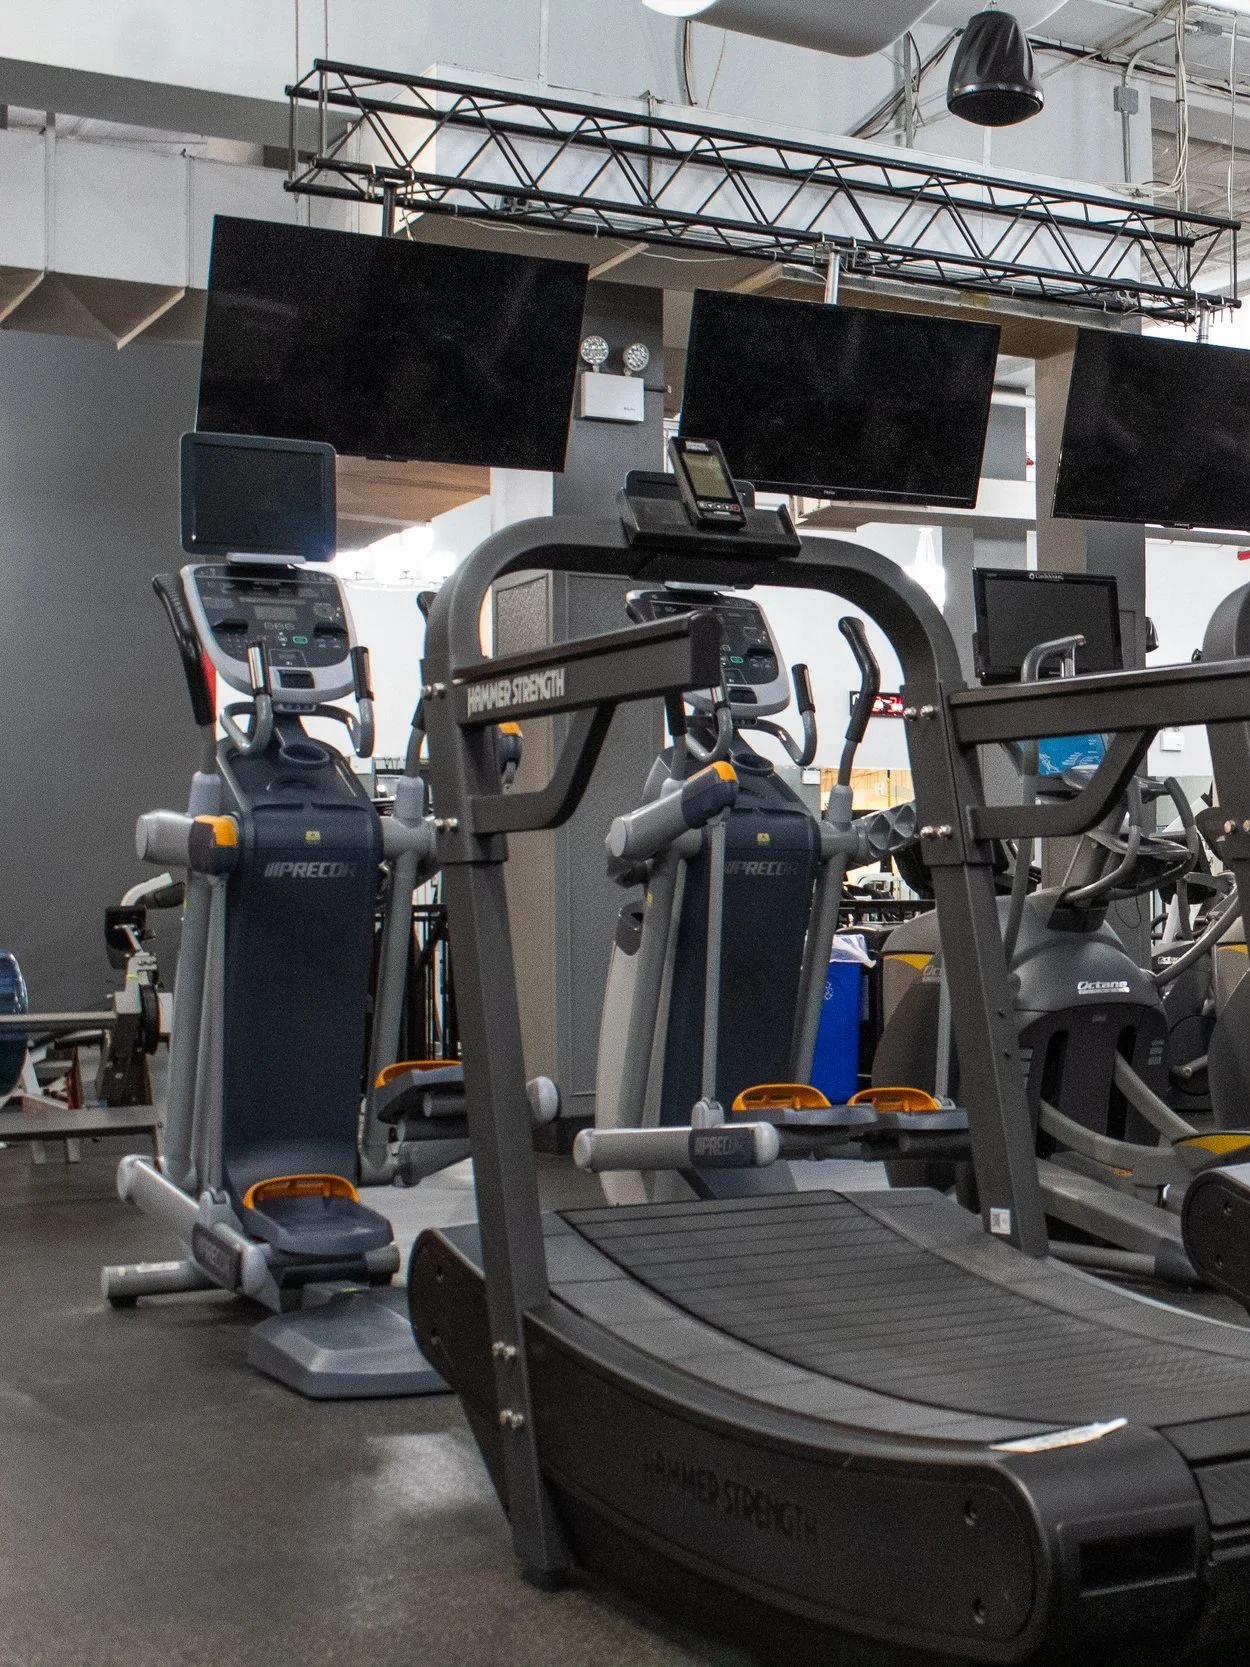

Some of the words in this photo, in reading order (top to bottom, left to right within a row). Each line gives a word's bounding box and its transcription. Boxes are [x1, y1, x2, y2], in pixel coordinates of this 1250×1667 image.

[467, 679, 511, 718] HAMMER
[512, 667, 566, 705] STRENGTH
[1077, 981, 1128, 990] Octane
